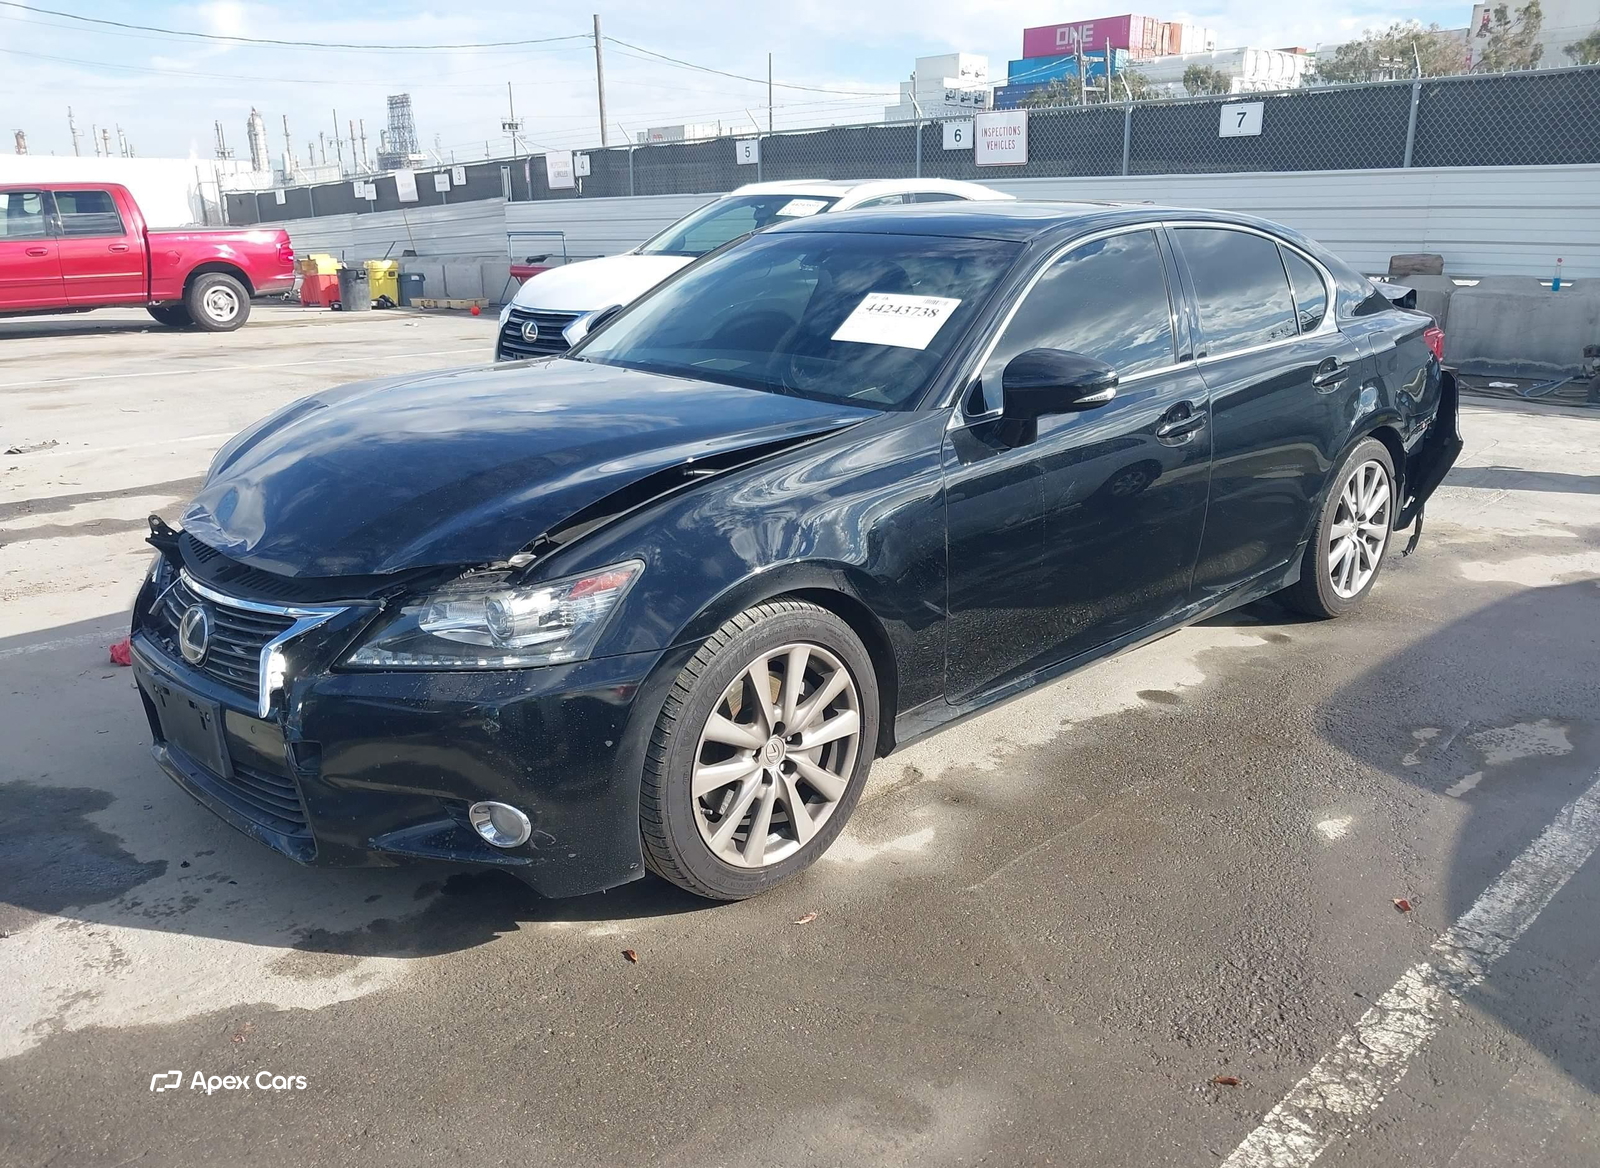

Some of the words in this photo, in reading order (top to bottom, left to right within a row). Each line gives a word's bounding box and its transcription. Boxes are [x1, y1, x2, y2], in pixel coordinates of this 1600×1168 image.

[1056, 24, 1094, 46] ONE
[1237, 112, 1247, 128] 7
[954, 128, 962, 143] 6
[981, 126, 1021, 138] INSPECTIONS
[744, 146, 751, 159] 5
[986, 140, 1016, 151] VEHICLES
[580, 161, 585, 171] 4
[865, 303, 940, 318] 44243738
[690, 643, 755, 723] MICHELIN
